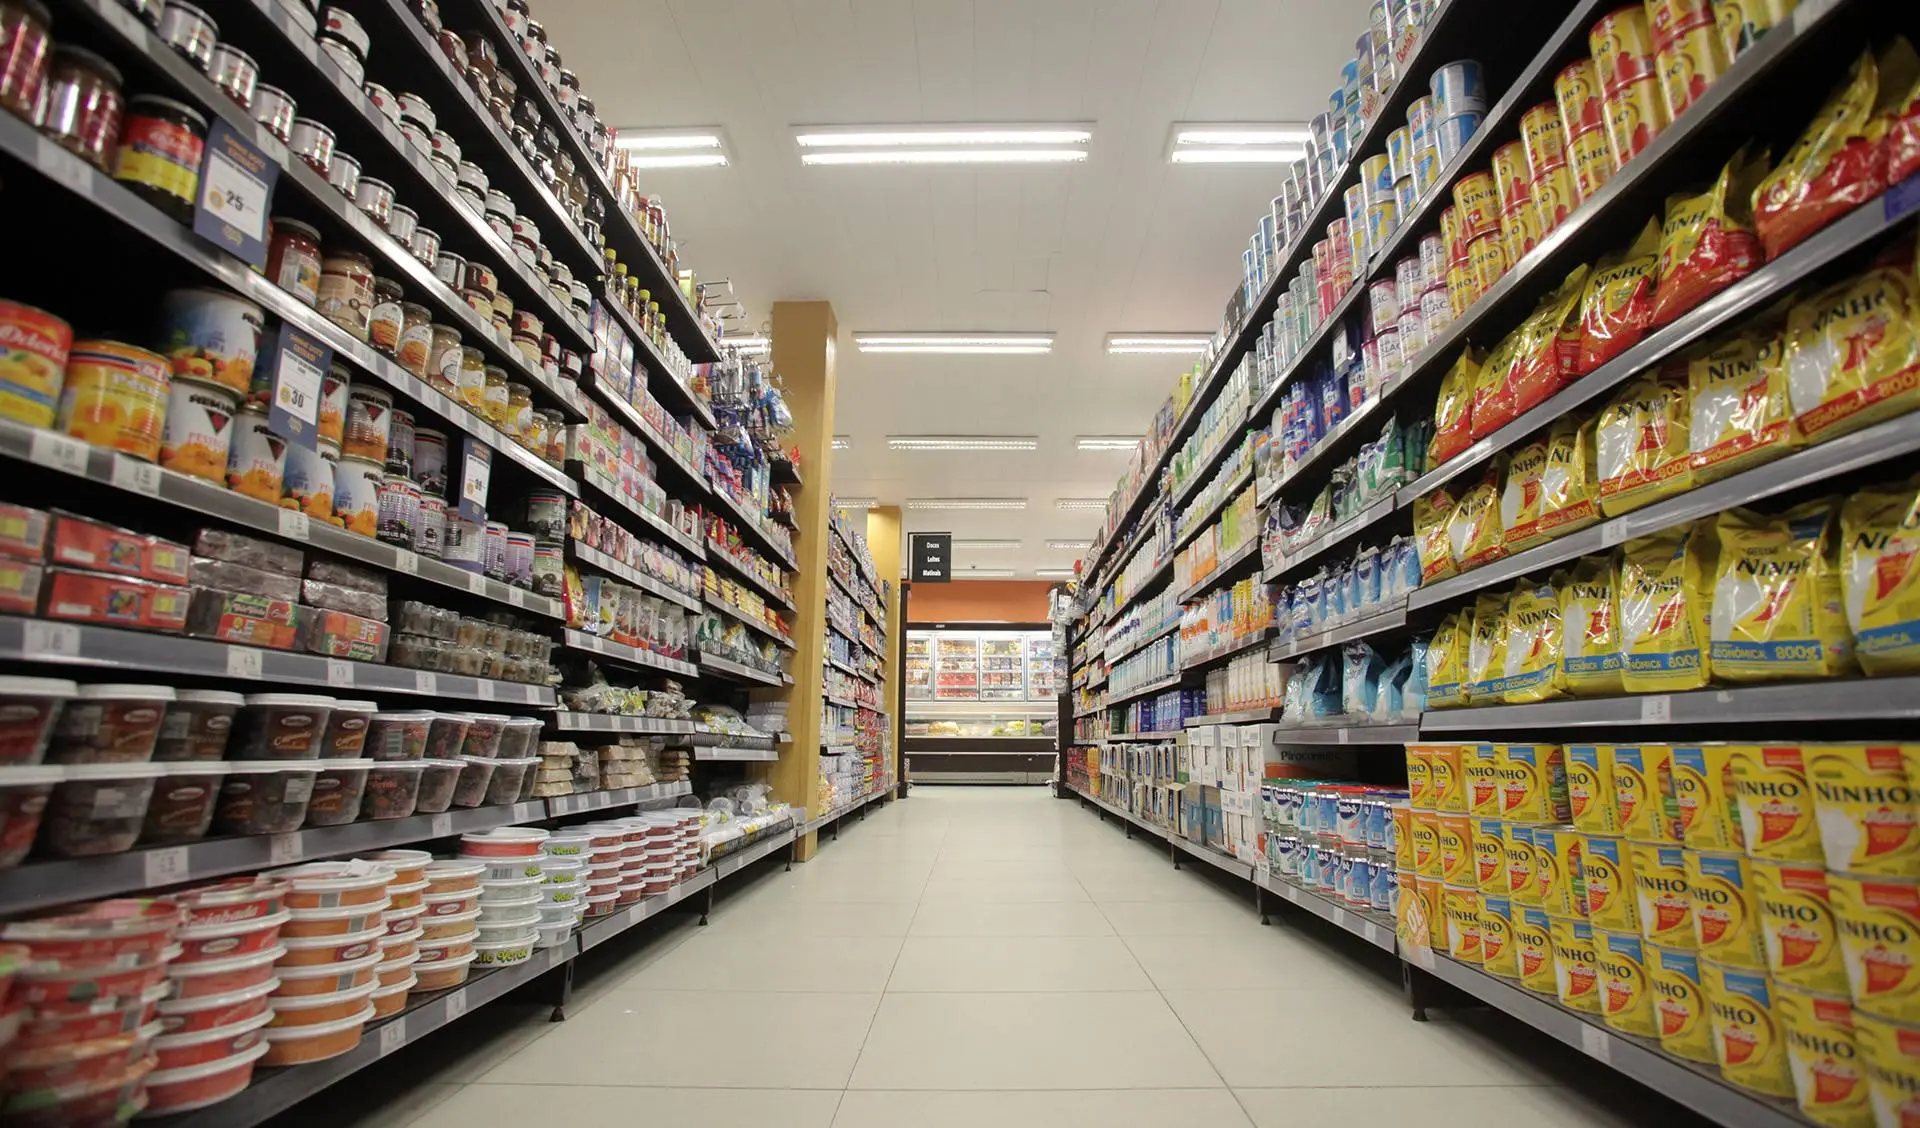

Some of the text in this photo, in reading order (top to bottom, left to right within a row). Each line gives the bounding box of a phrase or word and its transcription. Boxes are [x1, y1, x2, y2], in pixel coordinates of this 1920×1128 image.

[226, 189, 245, 212] 25
[291, 390, 304, 408] 30
[922, 569, 942, 577] Matinais
[1814, 781, 1912, 805] NINHO
